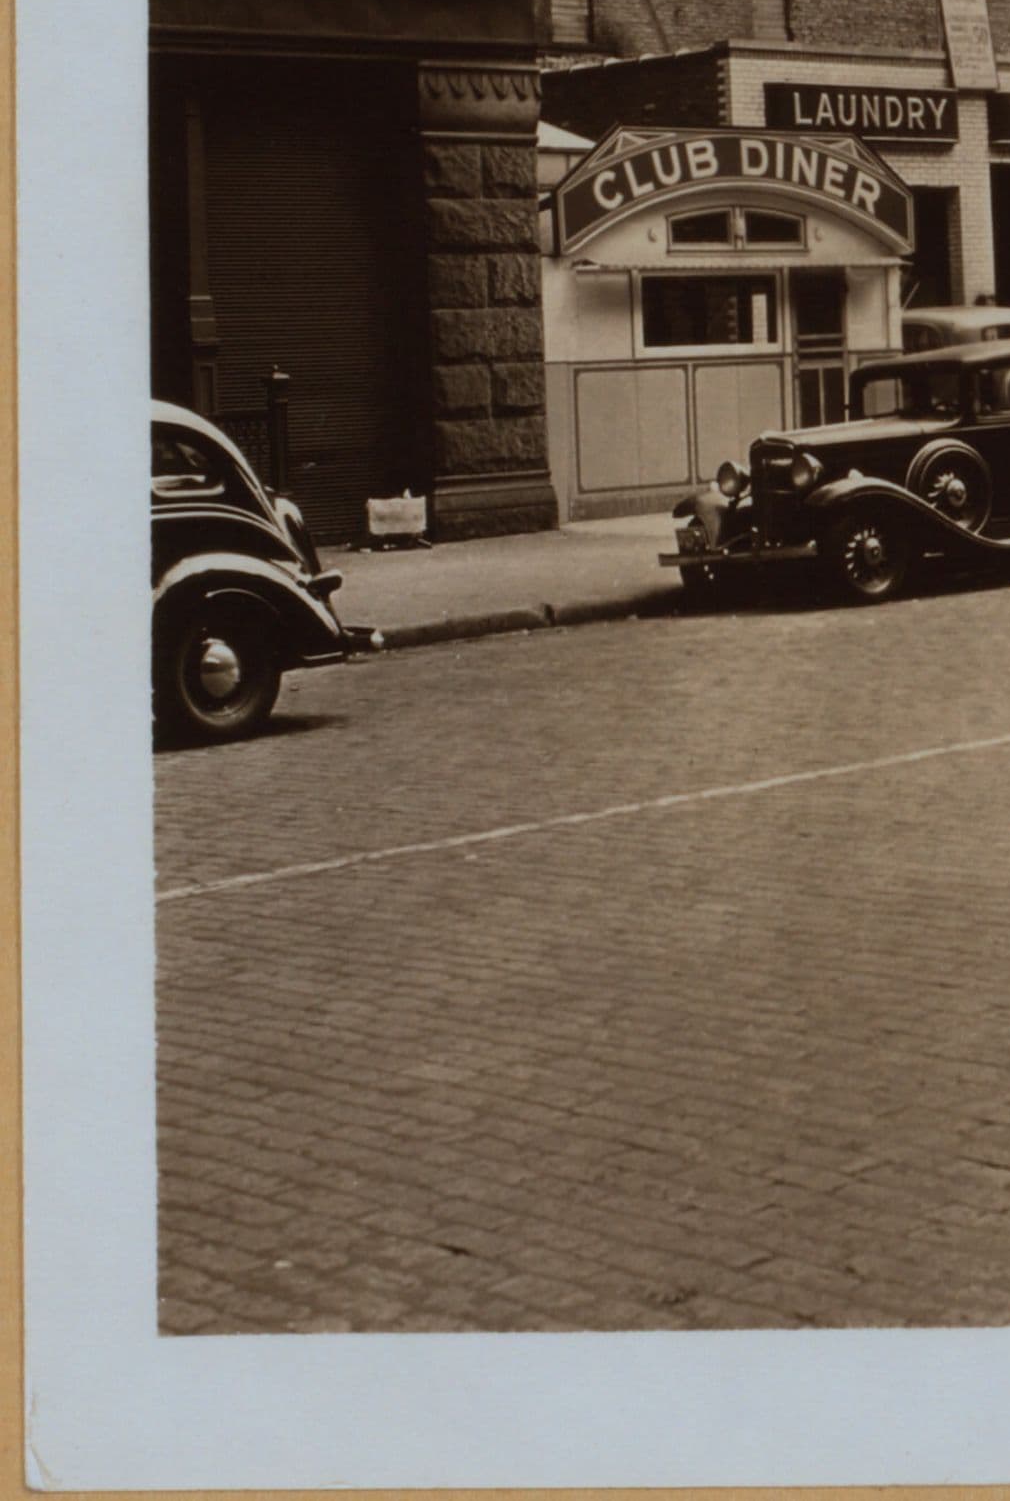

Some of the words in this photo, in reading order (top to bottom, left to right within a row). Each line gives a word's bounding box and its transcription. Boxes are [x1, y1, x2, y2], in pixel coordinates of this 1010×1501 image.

[793, 91, 948, 131] LAUNDRY
[593, 139, 719, 210] CLUB
[740, 139, 882, 215] DINER
